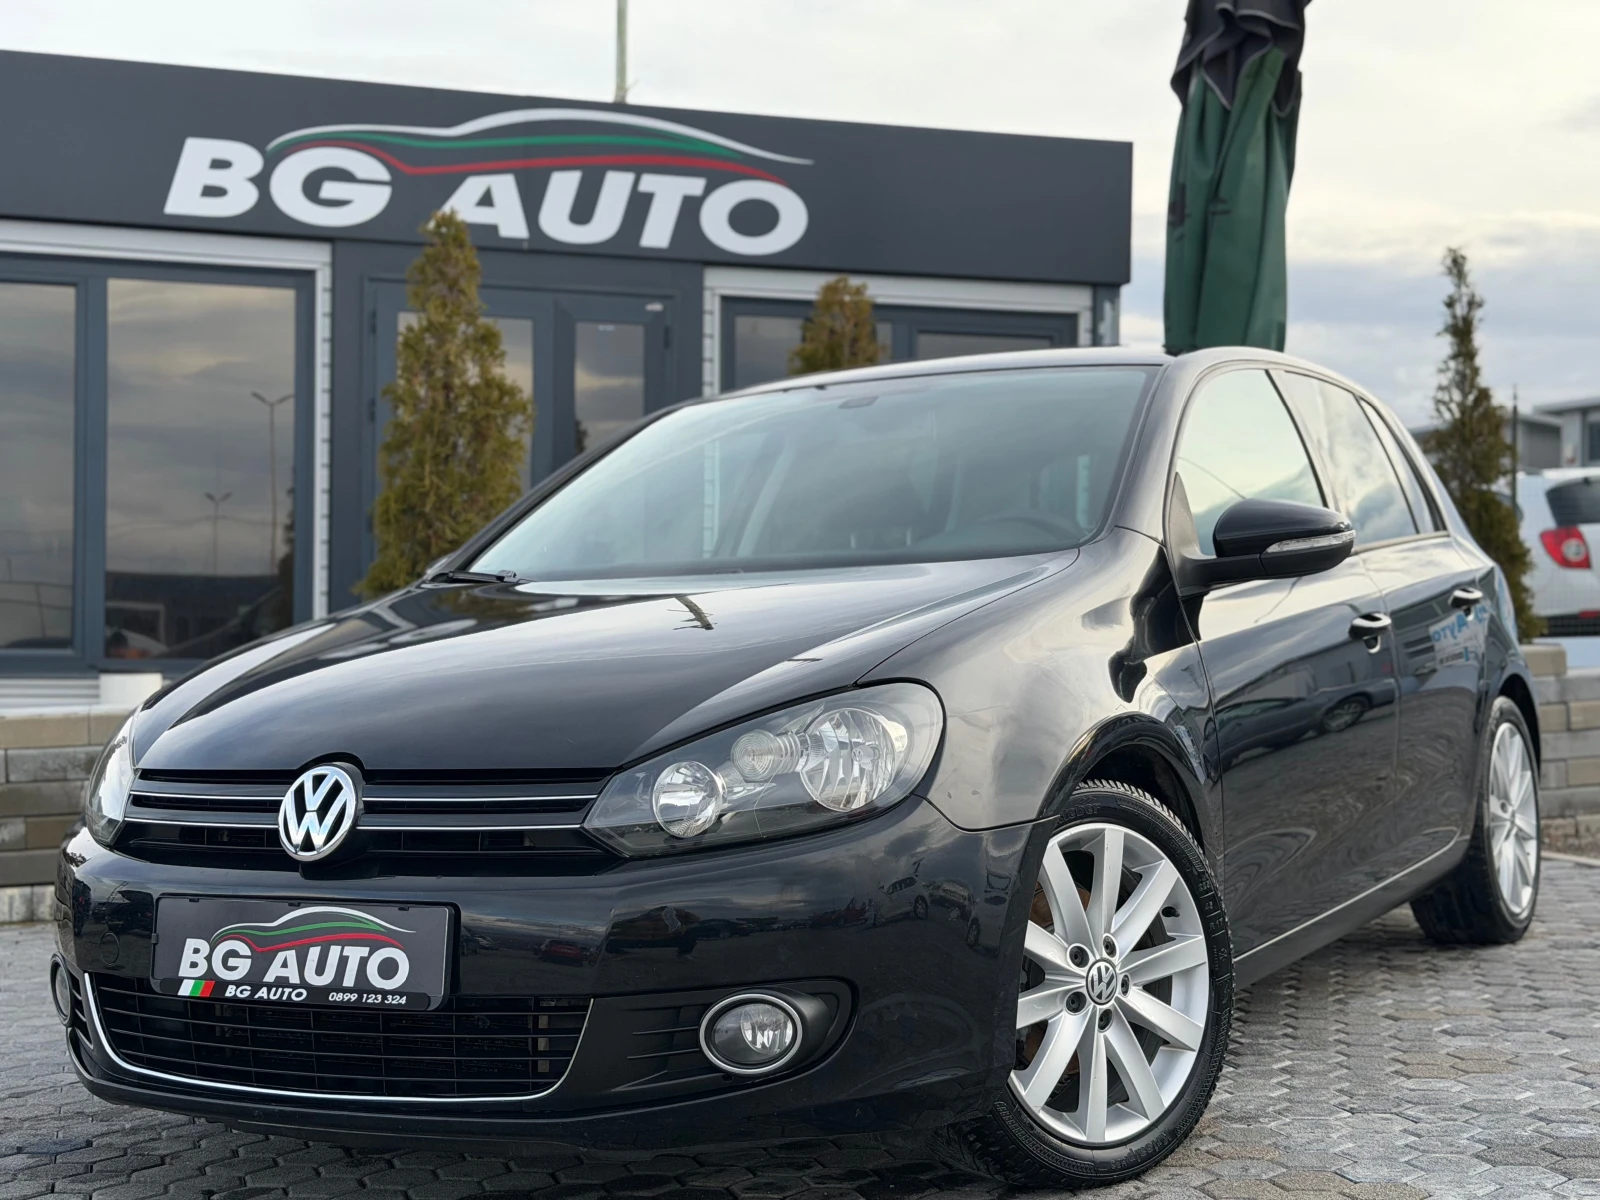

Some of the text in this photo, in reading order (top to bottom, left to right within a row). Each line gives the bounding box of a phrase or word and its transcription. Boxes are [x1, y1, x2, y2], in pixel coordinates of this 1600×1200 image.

[163, 137, 810, 257] BG AUTO
[279, 767, 355, 859] VW
[1057, 803, 1101, 824] leber
[178, 938, 410, 990] BG AUTO
[225, 984, 407, 1005] BG AUTO 0899 123 324
